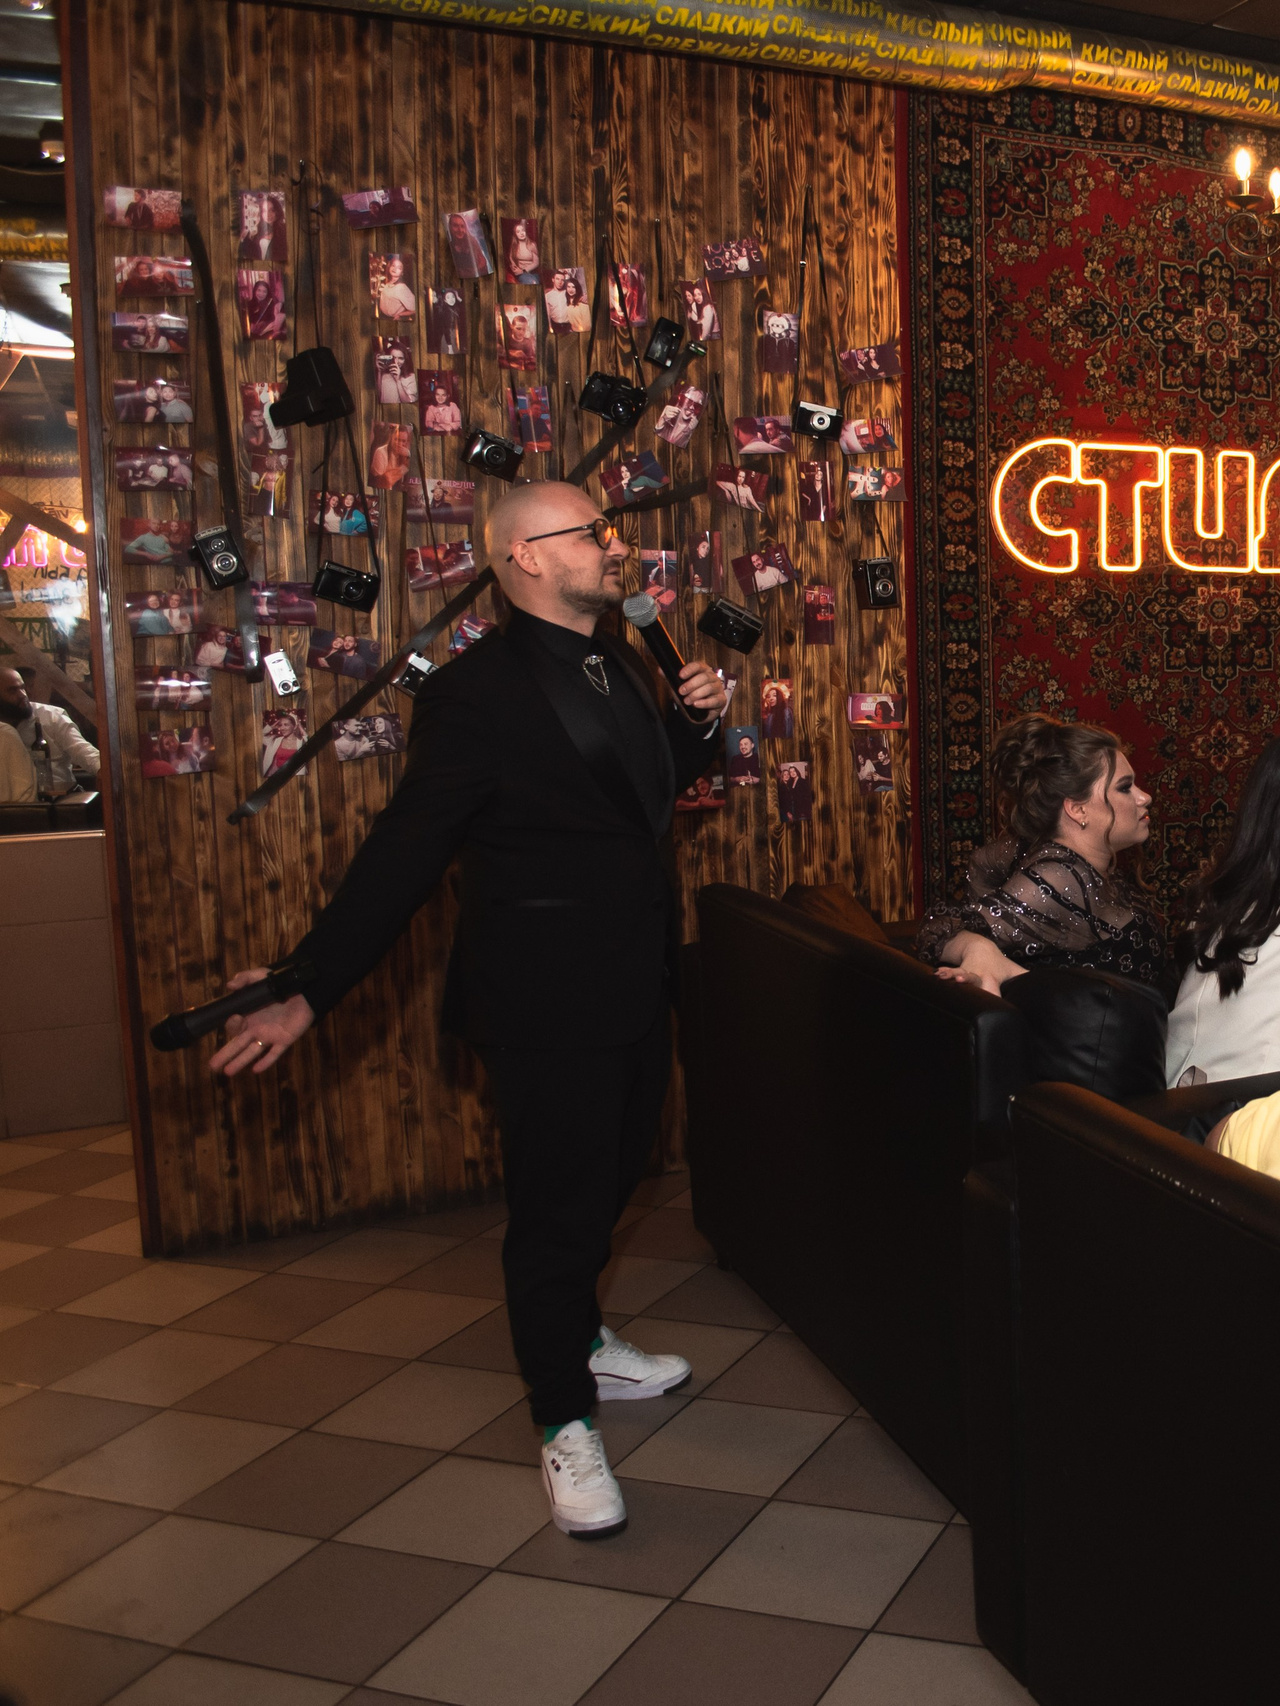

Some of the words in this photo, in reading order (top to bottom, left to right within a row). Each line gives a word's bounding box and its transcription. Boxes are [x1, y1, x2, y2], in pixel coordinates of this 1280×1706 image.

[400, 0, 528, 26] СВЕЖИЙ
[528, 5, 651, 37] СВЕЖИЙ
[642, 33, 760, 60] СВЕЖИЙ
[759, 43, 870, 73] СВЕЖИЙ
[655, 5, 770, 39] СЛАДКИЙ
[772, 14, 880, 49] СЛАДКИЙ
[1071, 70, 1163, 96] СЛАДКИЙ
[1166, 72, 1251, 103] СЛАДКИЙ
[885, 11, 983, 47] КИСЛЫЙ
[1080, 42, 1169, 73] КИСЛЫЙ
[1172, 48, 1253, 78] КИСЛЫЙ
